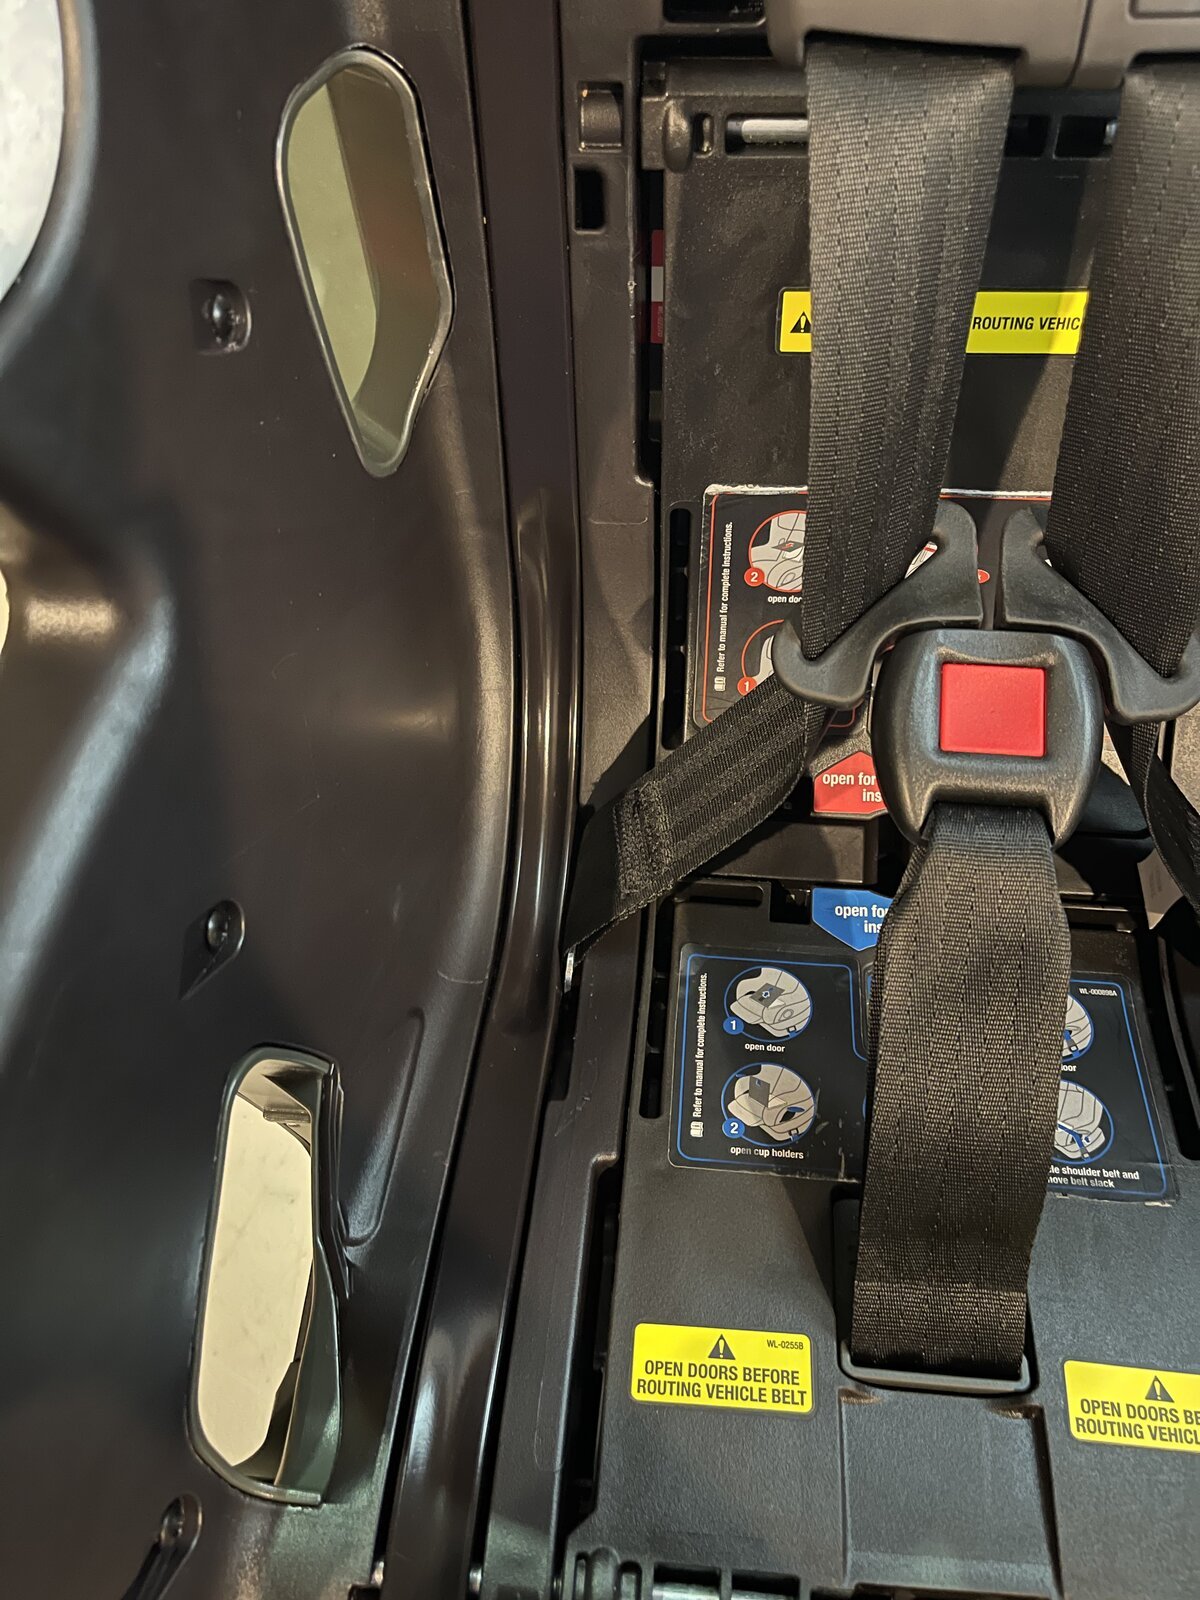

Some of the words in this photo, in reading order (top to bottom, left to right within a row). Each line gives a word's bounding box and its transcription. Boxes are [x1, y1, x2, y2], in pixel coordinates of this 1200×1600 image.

[972, 316, 1034, 330] ROUTING
[1039, 317, 1081, 331] VEHIC
[750, 572, 759, 583] 2
[721, 568, 731, 602] complete
[767, 595, 787, 604] open
[720, 602, 728, 614] for
[719, 614, 728, 642] manual
[718, 643, 726, 652] to
[716, 652, 725, 673] Refer
[744, 681, 750, 692] 1
[822, 773, 855, 787] open
[858, 772, 877, 786] for
[862, 788, 882, 802] ins
[835, 905, 868, 919] open
[697, 973, 708, 1015] instructions.
[696, 1015, 706, 1047] complete
[730, 1020, 736, 1031] 1
[695, 1047, 704, 1059] for
[744, 1043, 765, 1052] open
[766, 1043, 785, 1053] door
[695, 1059, 704, 1087] manual
[694, 1087, 703, 1097] to
[692, 1097, 702, 1118] Refer
[730, 1122, 739, 1134] 2
[730, 1146, 752, 1156] open
[753, 1147, 770, 1158] cup
[771, 1148, 804, 1159] holders
[1061, 1166, 1101, 1177] shoulder
[1102, 1168, 1121, 1179] belt
[1122, 1171, 1140, 1180] and
[1070, 1176, 1088, 1187] belt
[1089, 1179, 1115, 1188] slack
[767, 1339, 804, 1350] WL-0255B
[644, 1360, 683, 1377] OPEN
[688, 1363, 738, 1381] DOORS
[742, 1367, 800, 1385] BEFORE
[637, 1379, 702, 1398] ROUTING
[706, 1384, 767, 1402] VEHICLE
[771, 1389, 807, 1406] BELT
[1080, 1398, 1122, 1418] OPEN
[1126, 1403, 1180, 1424] DOORS
[1183, 1409, 1200, 1426] BE
[1075, 1417, 1144, 1439] ROUTING
